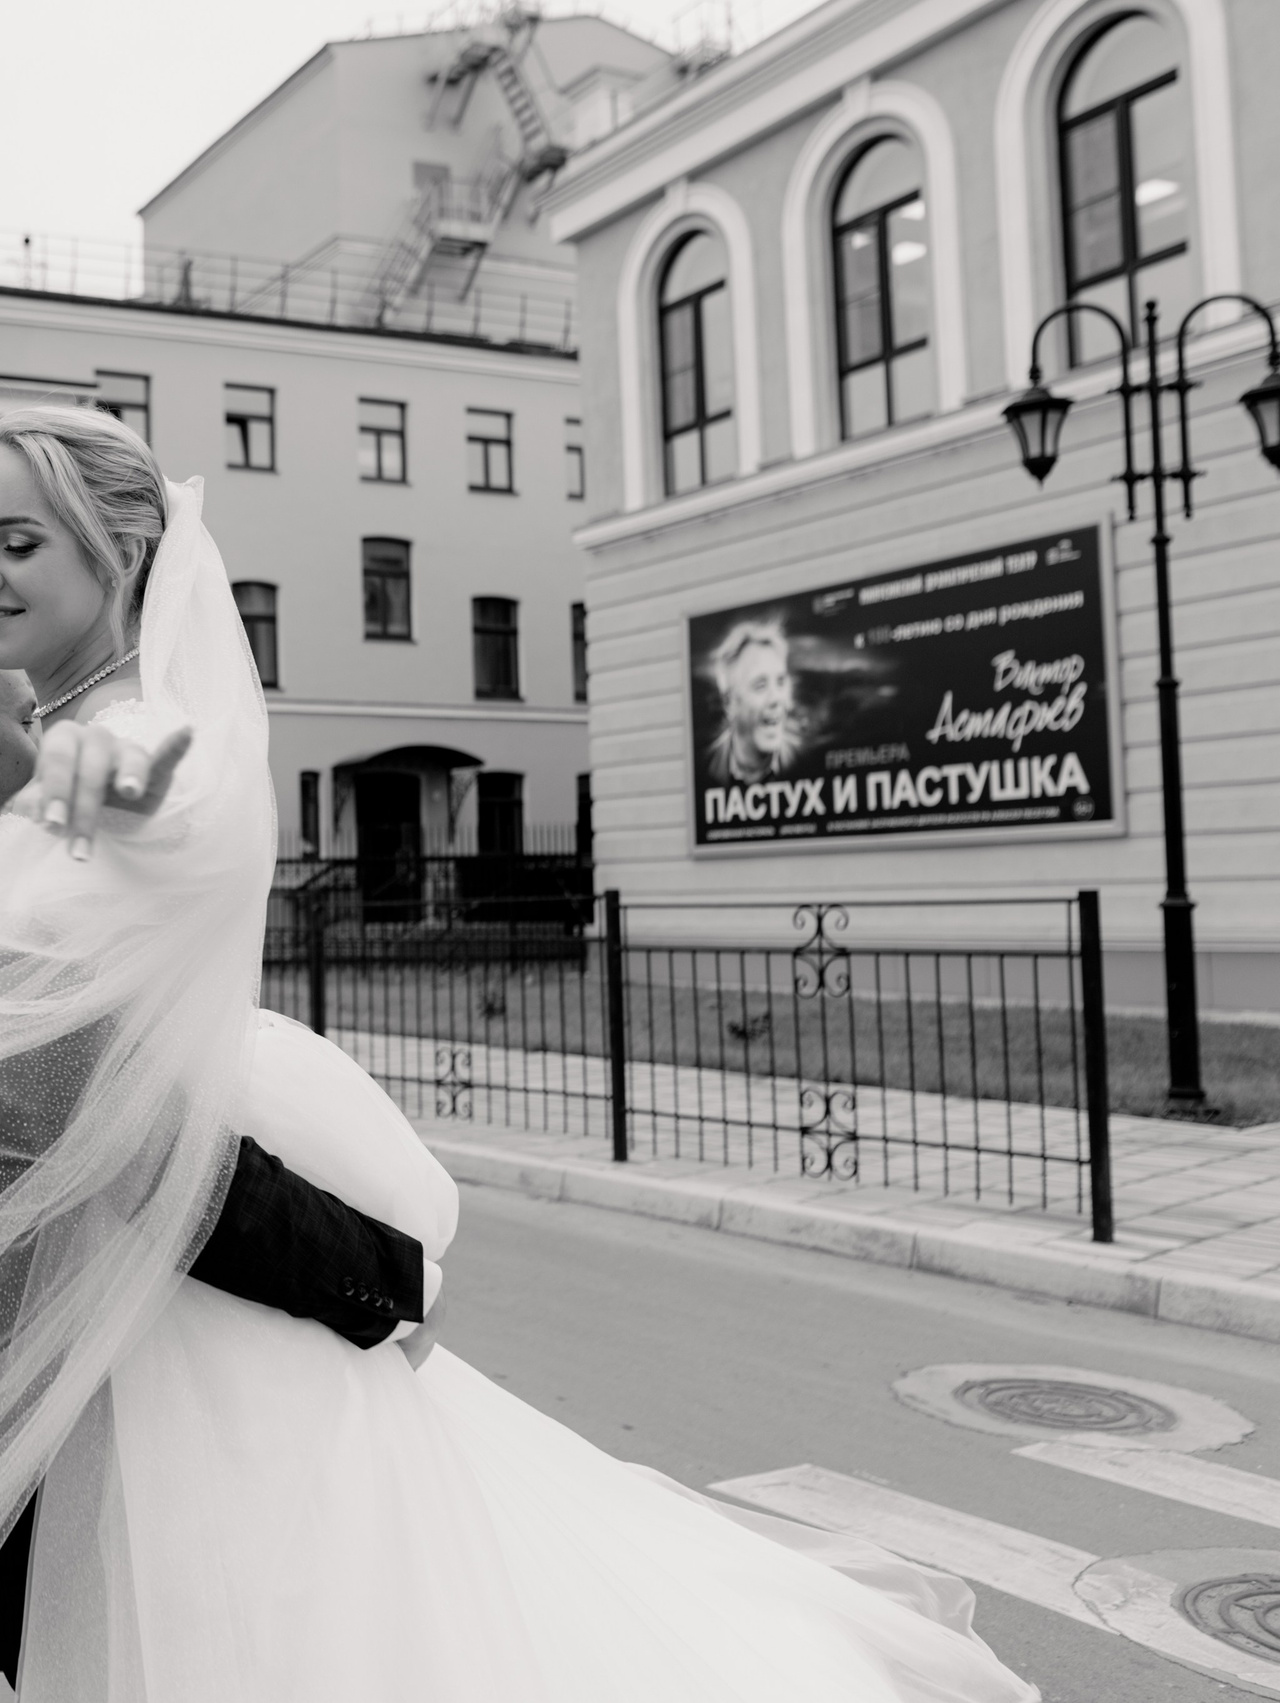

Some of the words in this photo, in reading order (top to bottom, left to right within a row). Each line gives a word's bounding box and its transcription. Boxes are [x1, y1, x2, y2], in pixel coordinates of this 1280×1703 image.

[997, 590, 1085, 626] рождения
[925, 681, 1088, 753] Астафьев
[825, 742, 910, 769] ПРЕМЬЕРА
[705, 777, 826, 824] ПАСТУХ
[832, 773, 858, 814] И
[866, 752, 1090, 811] ПАСТУШКА
